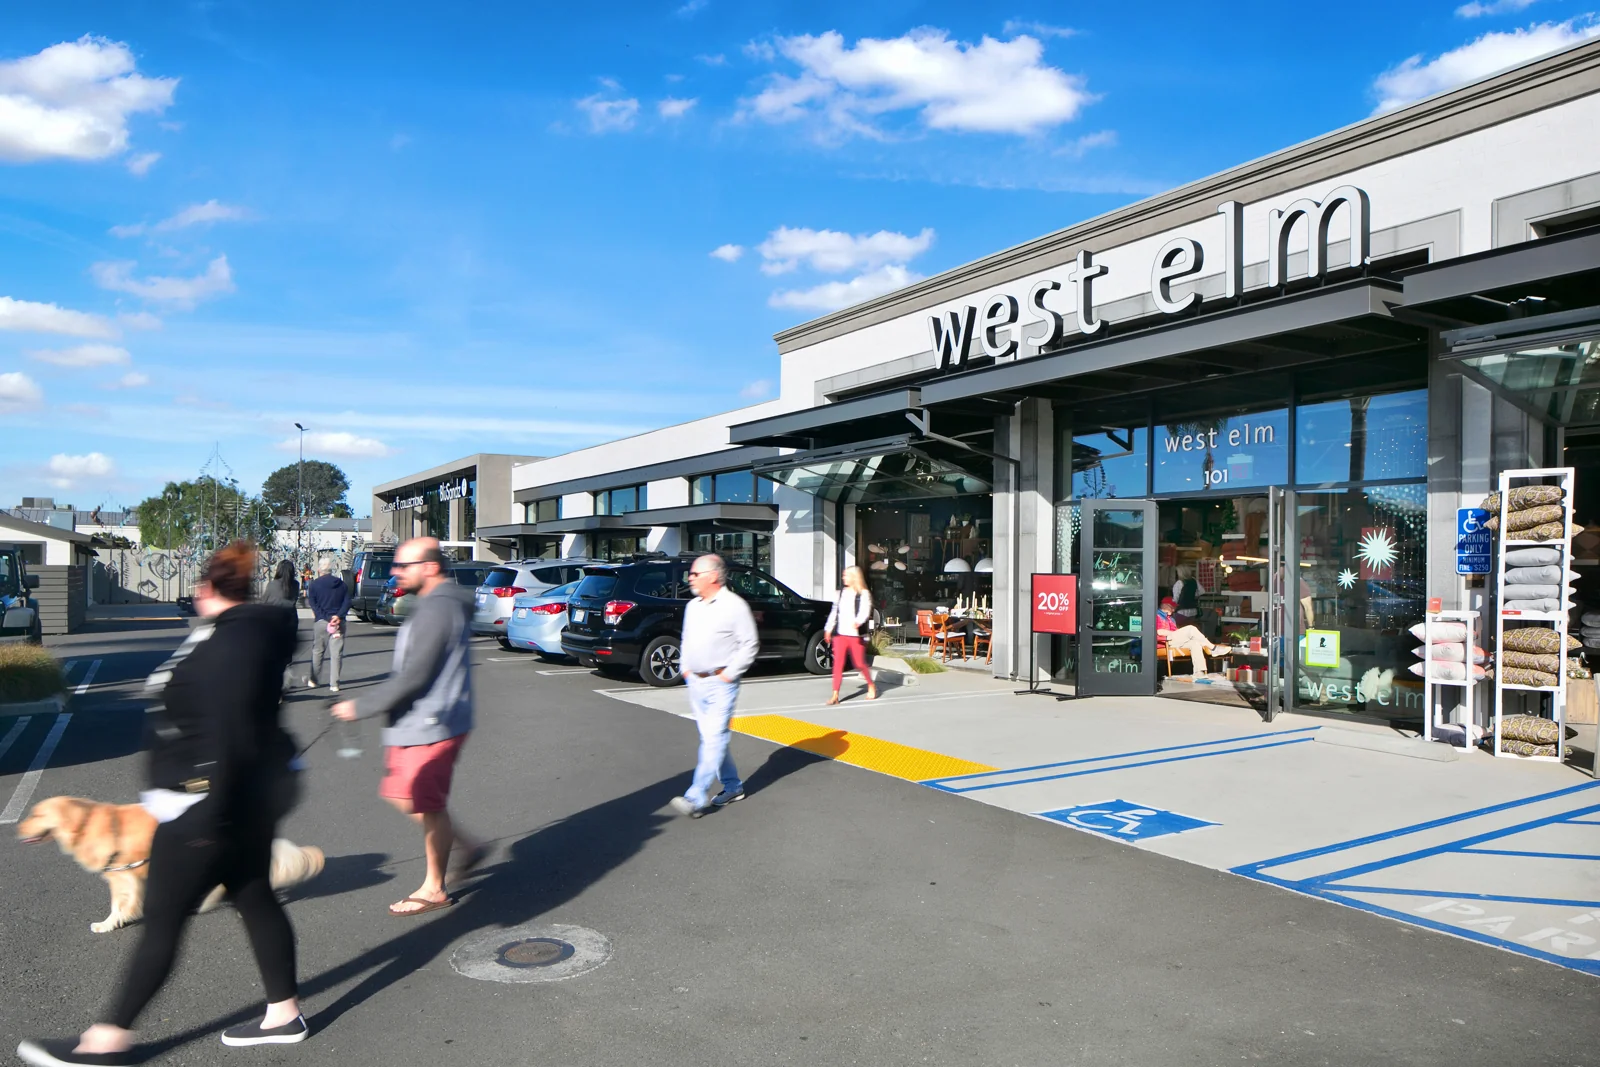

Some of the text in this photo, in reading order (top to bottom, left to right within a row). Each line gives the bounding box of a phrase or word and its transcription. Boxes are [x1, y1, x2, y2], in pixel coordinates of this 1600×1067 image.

[926, 184, 1371, 370] west elm
[1164, 423, 1275, 453] west elm
[1204, 468, 1228, 485] 101
[1458, 533, 1490, 543] PARKING
[1464, 544, 1484, 554] ONLY
[1462, 556, 1486, 564] MINIMUM
[1038, 592, 1069, 611] 20%
[1307, 680, 1425, 709] west elm
[1413, 900, 1600, 960] PAR
